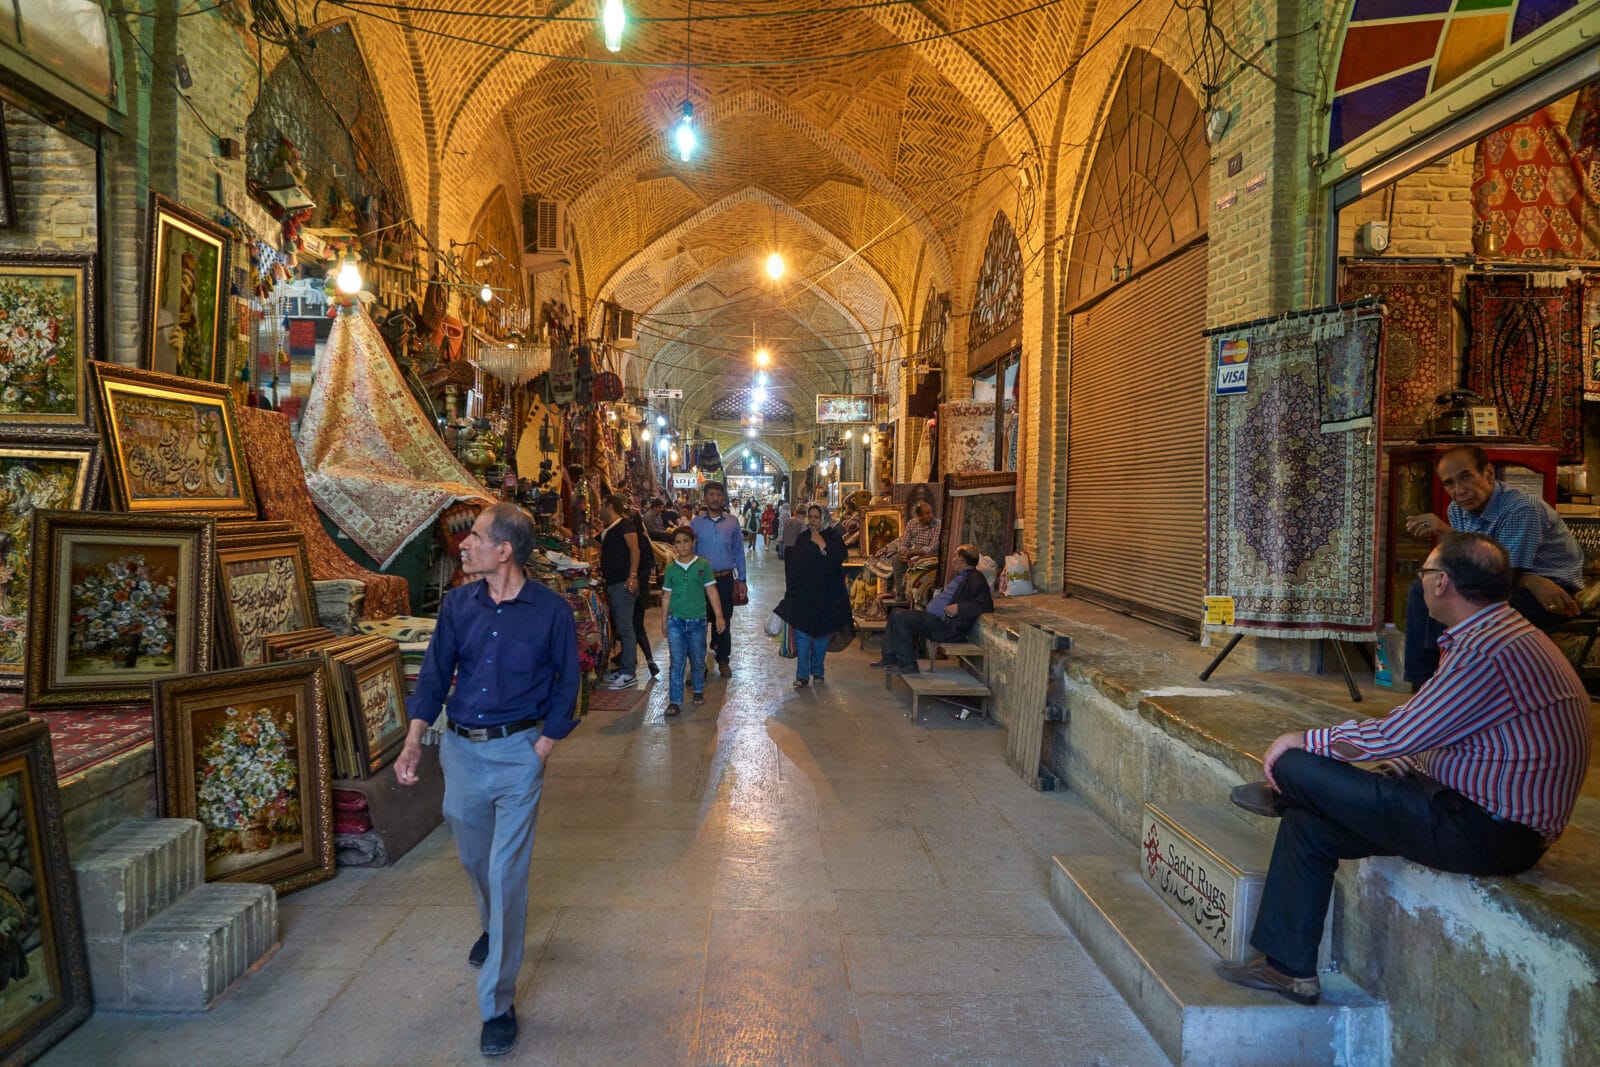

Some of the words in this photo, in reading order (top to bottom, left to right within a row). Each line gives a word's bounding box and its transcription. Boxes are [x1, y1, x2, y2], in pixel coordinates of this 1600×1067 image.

[1222, 370, 1245, 384] VISA
[1168, 843, 1195, 885] Sadri
[1197, 866, 1227, 911] Rugs
